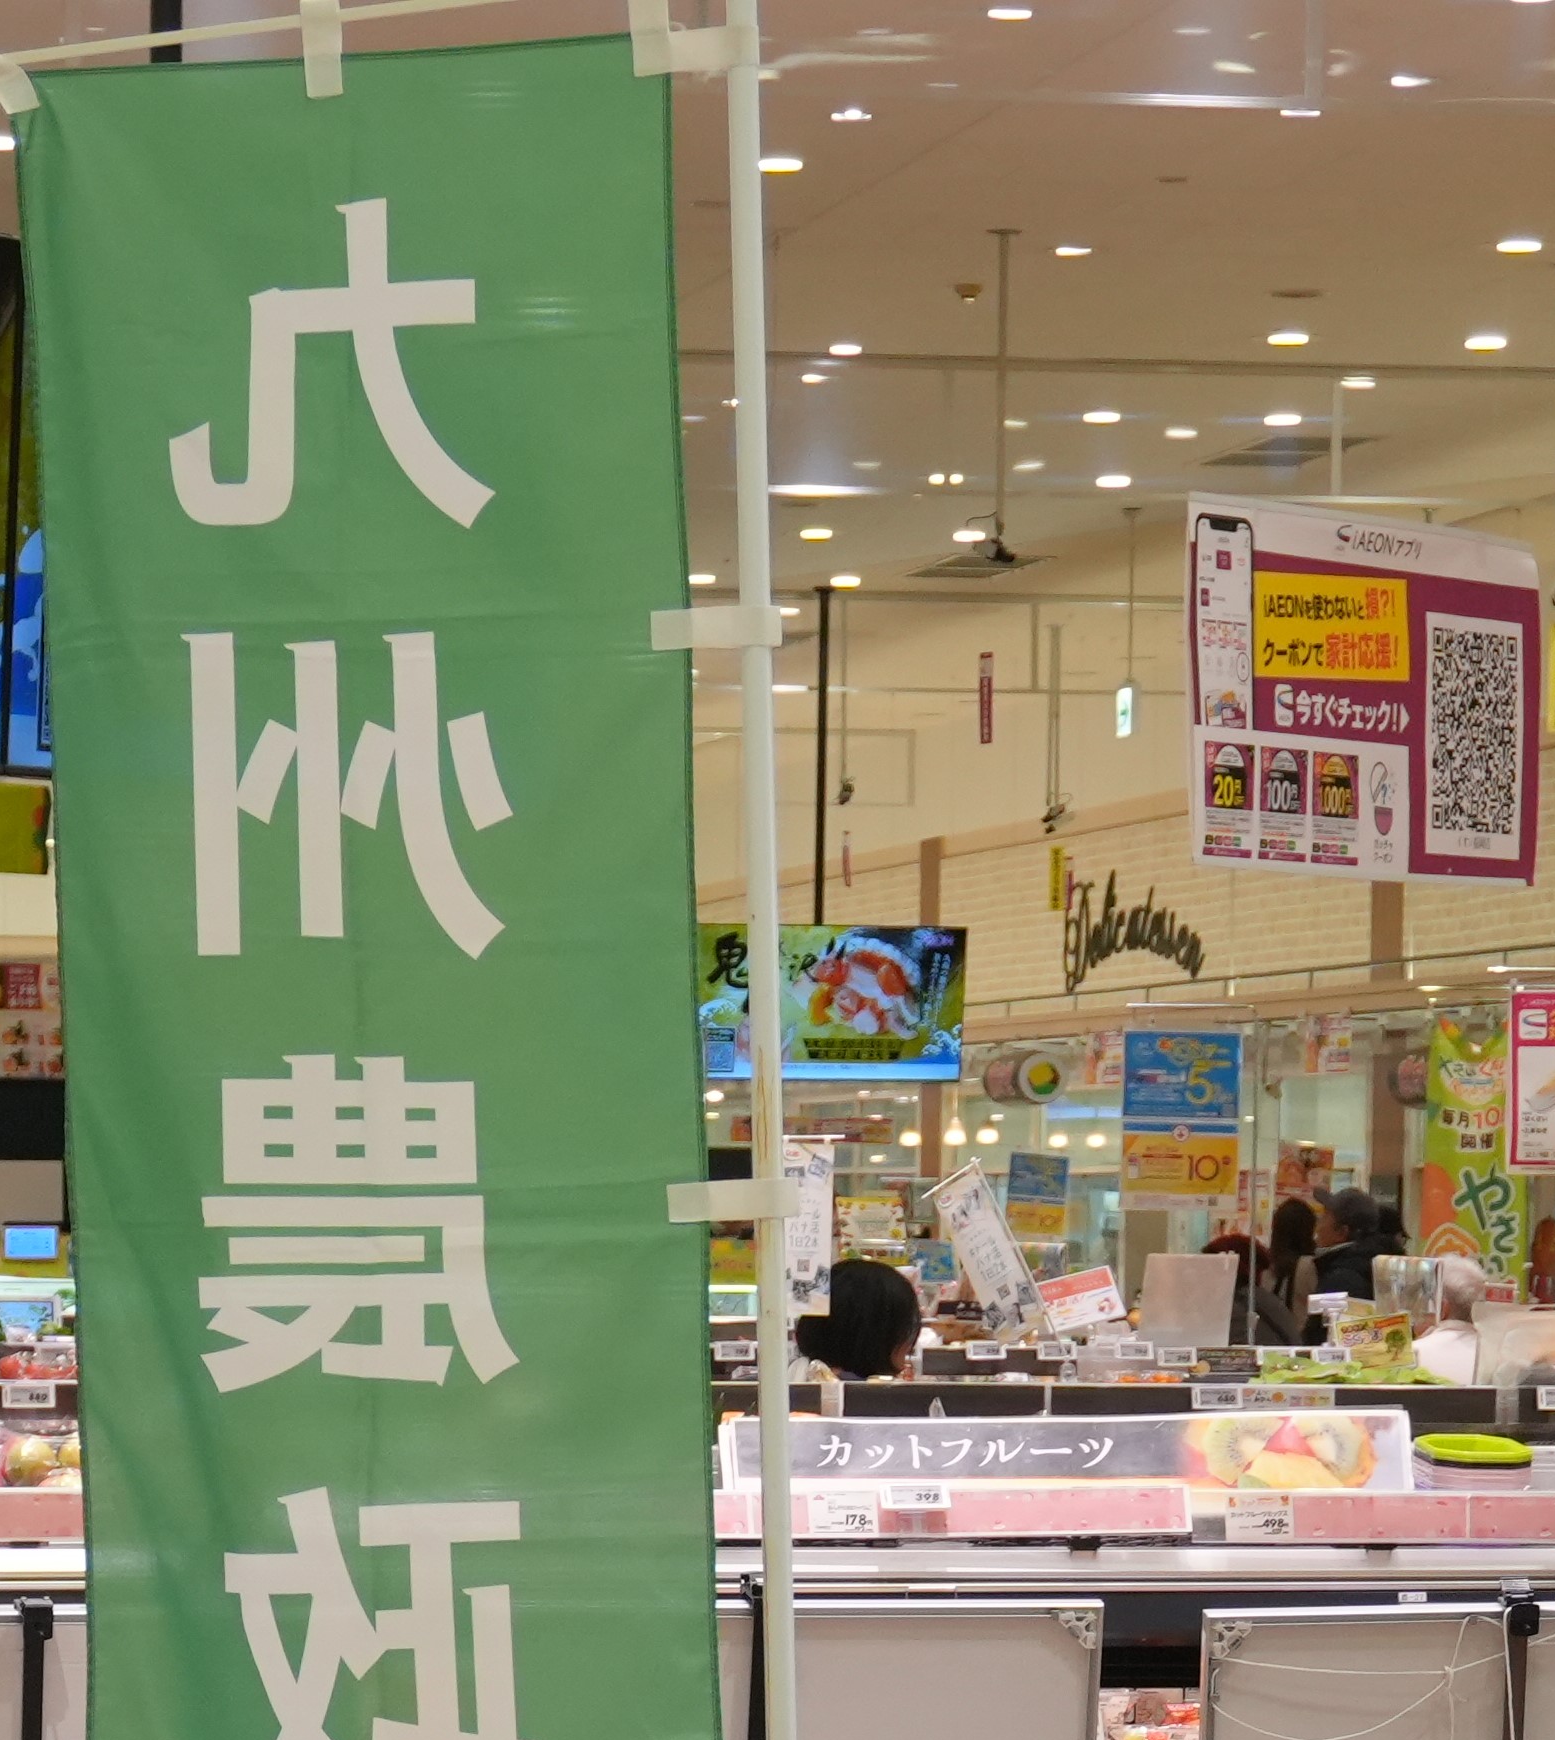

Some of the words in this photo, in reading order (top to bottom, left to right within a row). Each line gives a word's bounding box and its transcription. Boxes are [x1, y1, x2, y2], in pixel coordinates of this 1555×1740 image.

[816, 1434, 1115, 1469] カットフルーツ
